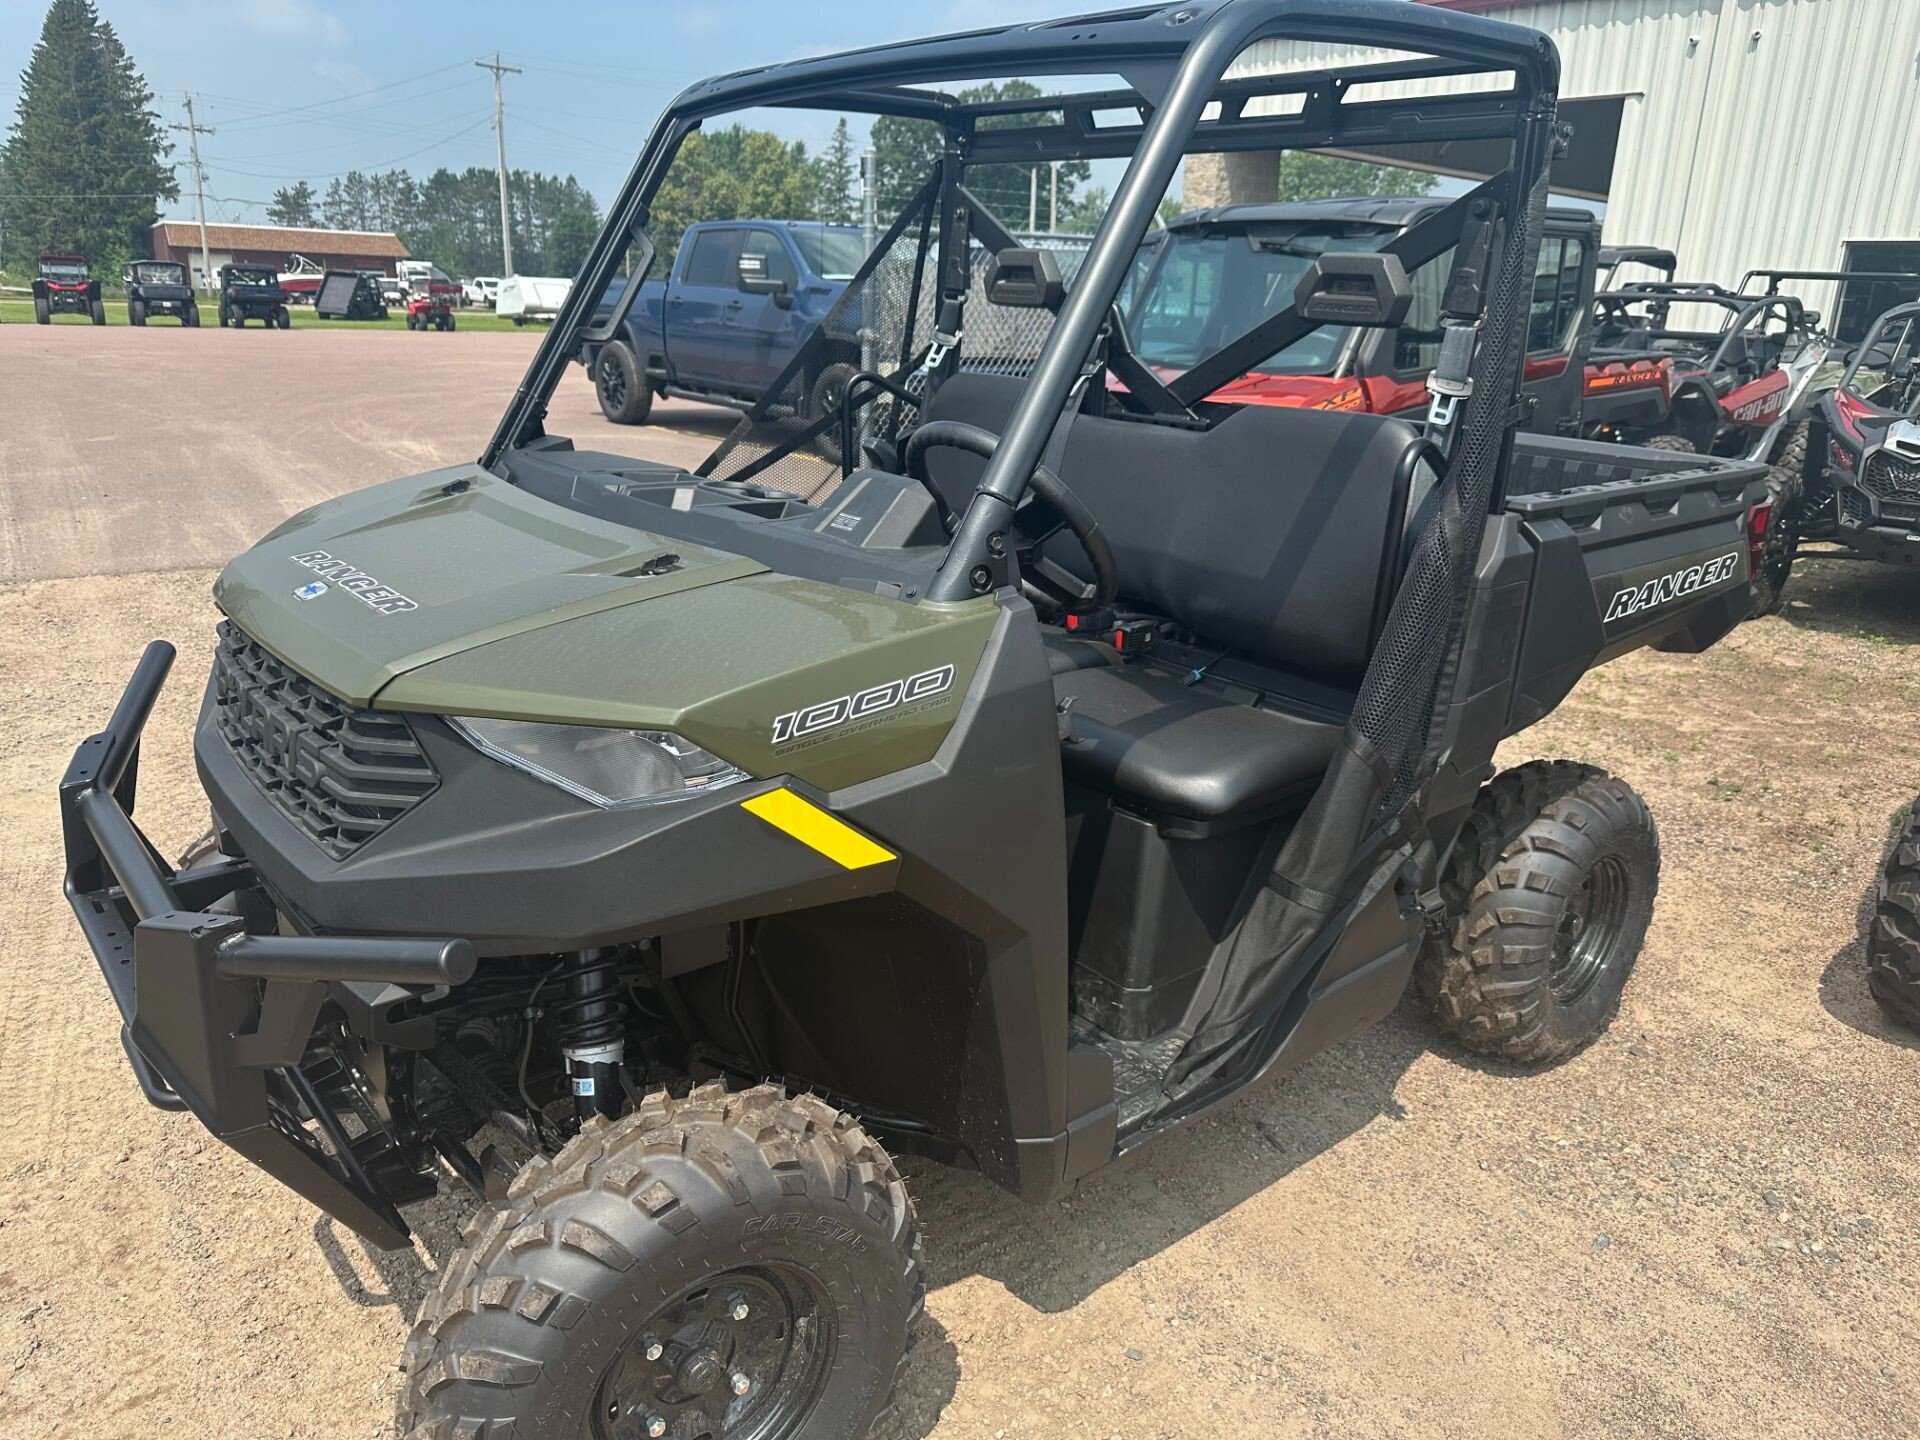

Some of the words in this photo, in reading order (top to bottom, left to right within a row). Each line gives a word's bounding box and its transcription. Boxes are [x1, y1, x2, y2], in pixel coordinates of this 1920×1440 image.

[288, 550, 419, 615] RANGER
[1603, 552, 1738, 623] RANGER
[771, 664, 956, 744] 1000
[774, 733, 833, 757] SINGLE
[838, 706, 918, 738] OVERHEAD
[919, 695, 952, 711] CAM
[743, 1212, 870, 1256] CARLSTAR
